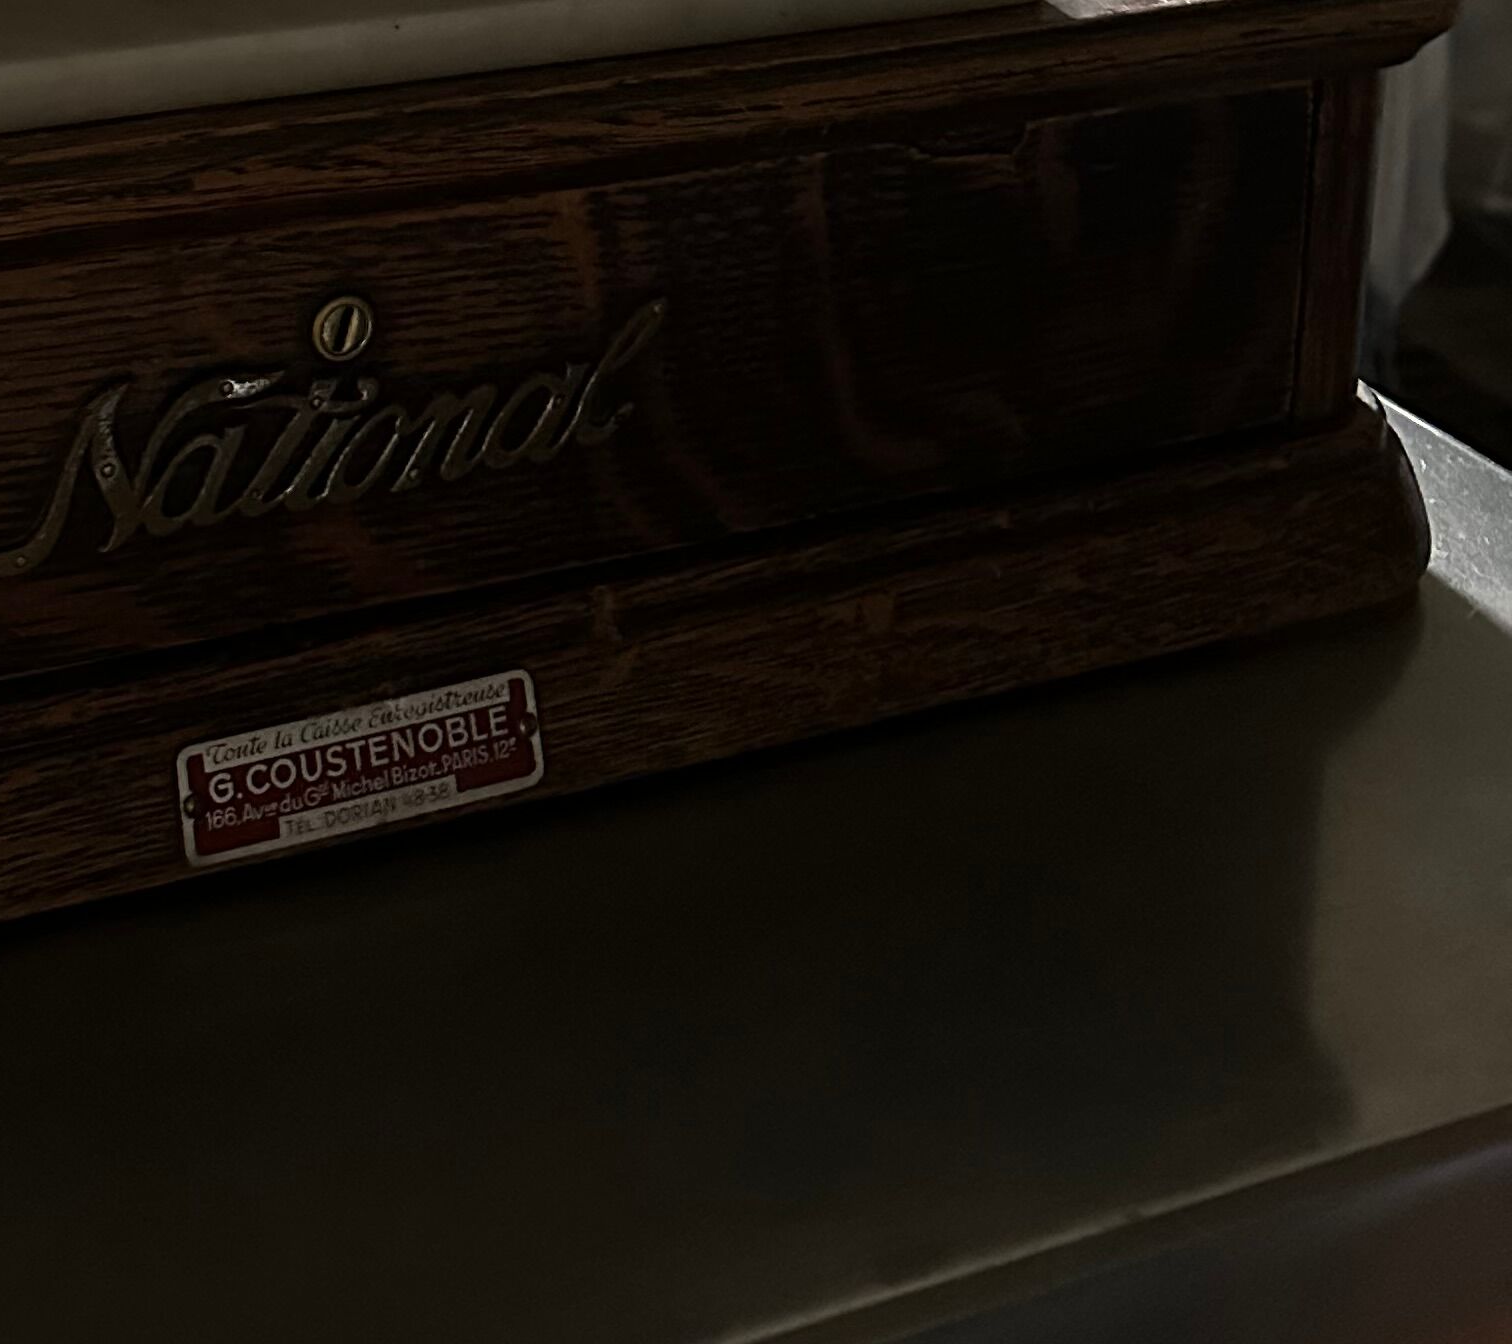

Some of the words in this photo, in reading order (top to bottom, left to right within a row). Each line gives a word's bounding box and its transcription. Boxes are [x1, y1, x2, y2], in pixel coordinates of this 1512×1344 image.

[206, 736, 268, 764] Toute
[274, 730, 293, 749] la
[300, 716, 363, 744] Caisse
[330, 769, 389, 801] Michel
